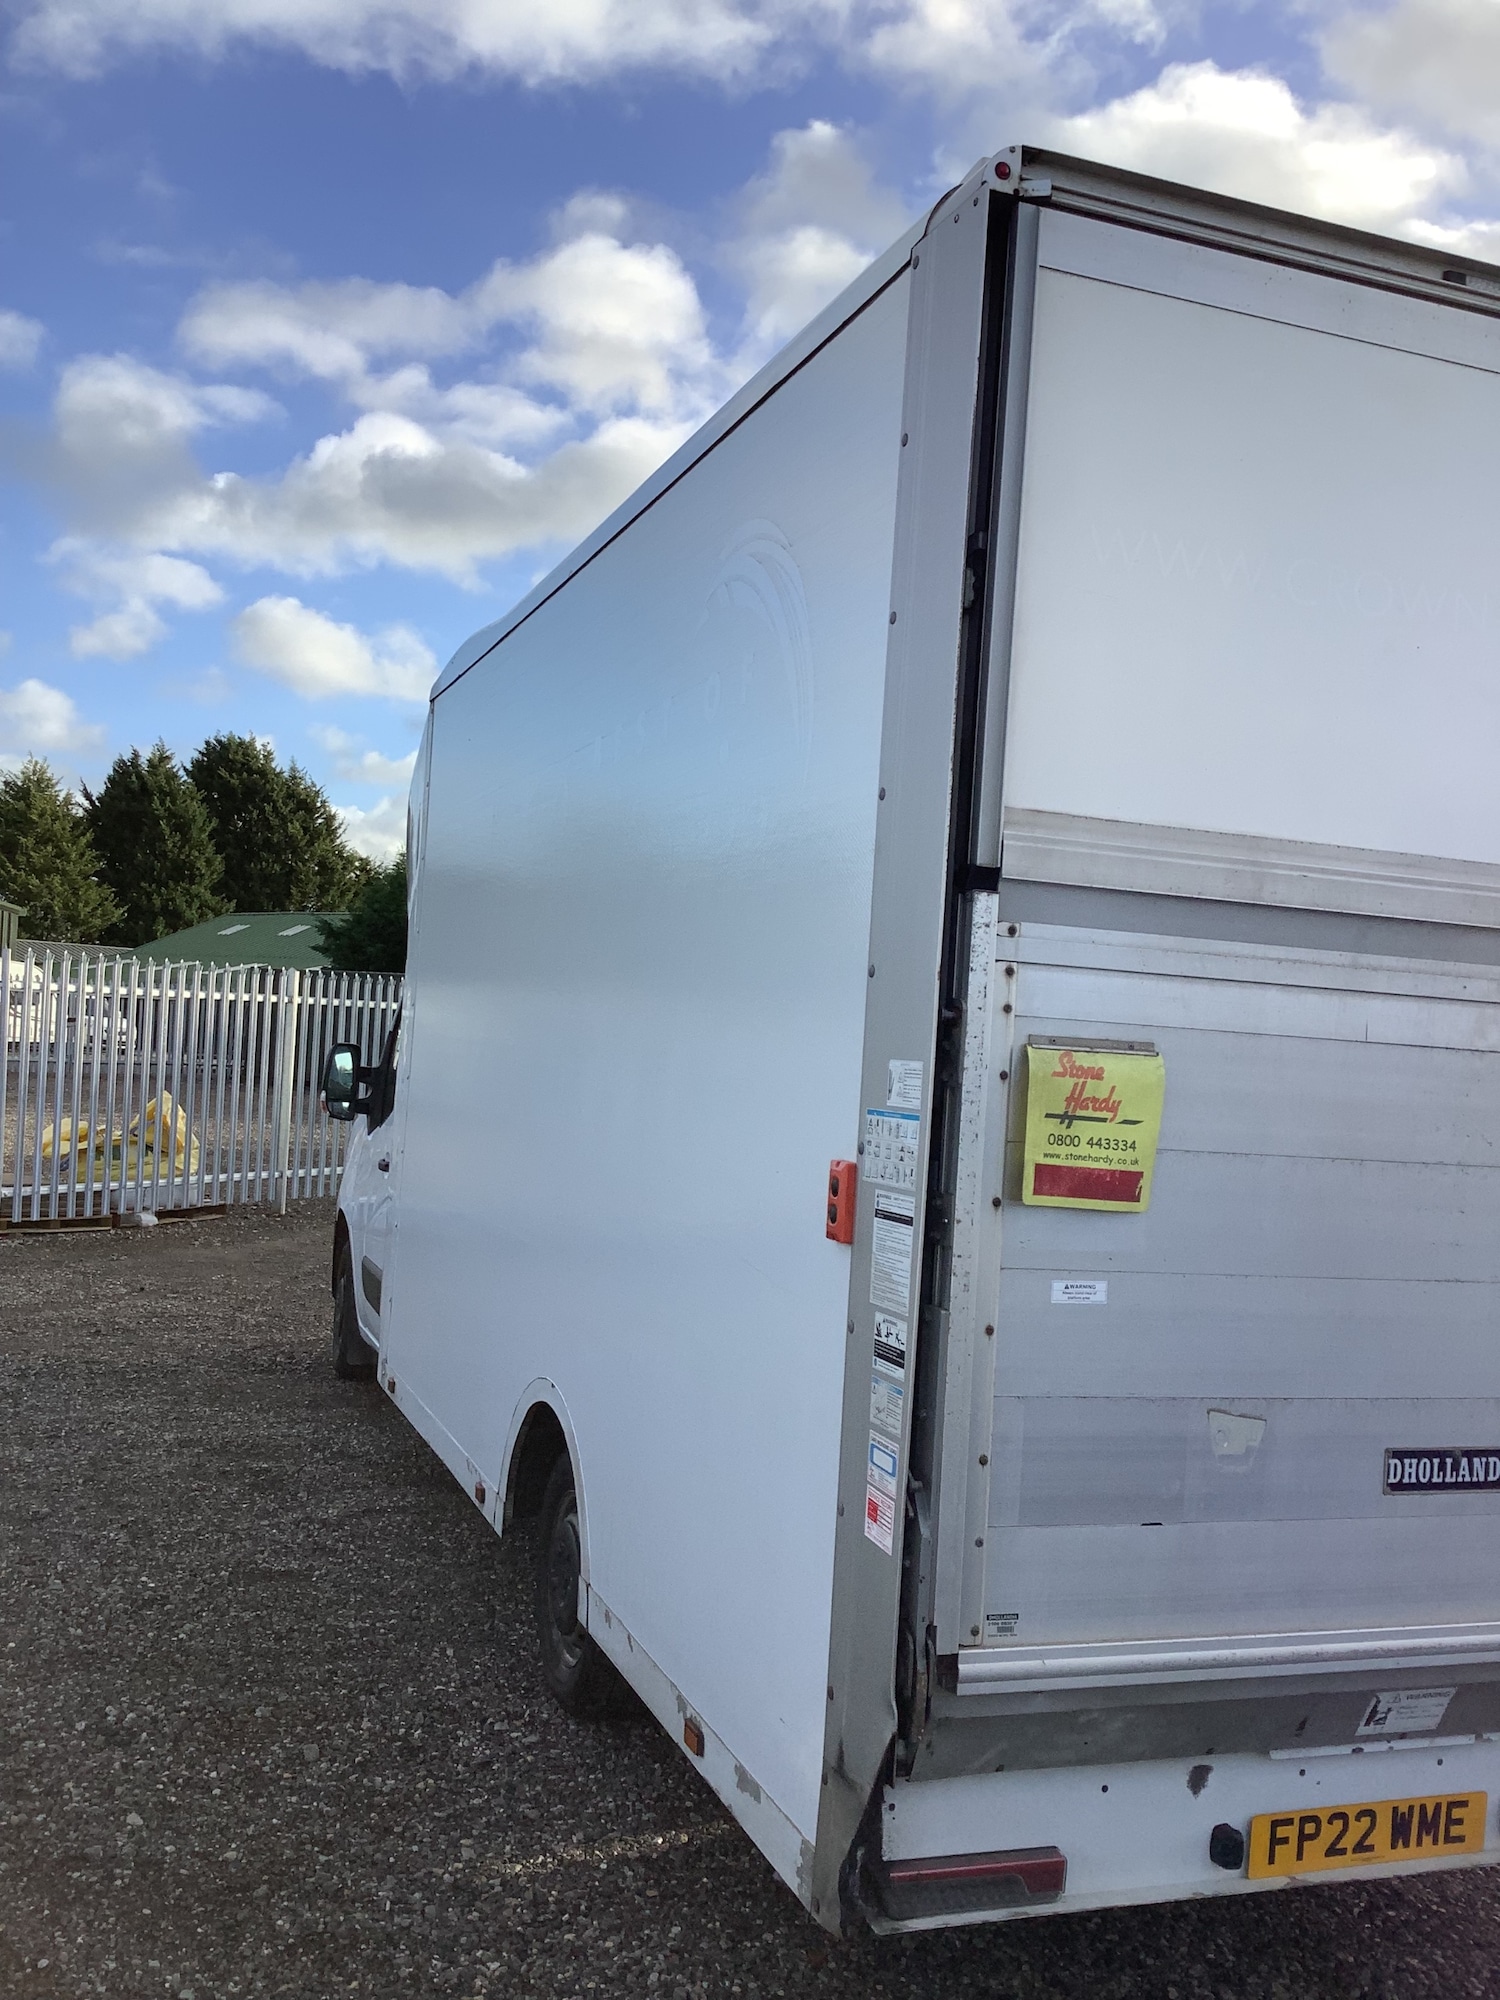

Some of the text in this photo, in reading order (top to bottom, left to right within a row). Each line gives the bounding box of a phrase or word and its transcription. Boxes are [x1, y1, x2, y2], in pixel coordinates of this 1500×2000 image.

[1051, 1051, 1105, 1081] Stone
[1064, 1081, 1122, 1123] Hardy
[1047, 1133, 1137, 1152] 0800 443334
[1042, 1151, 1139, 1166] www.stonehardy.co.uk
[1268, 1800, 1469, 1865] FP22 WME
